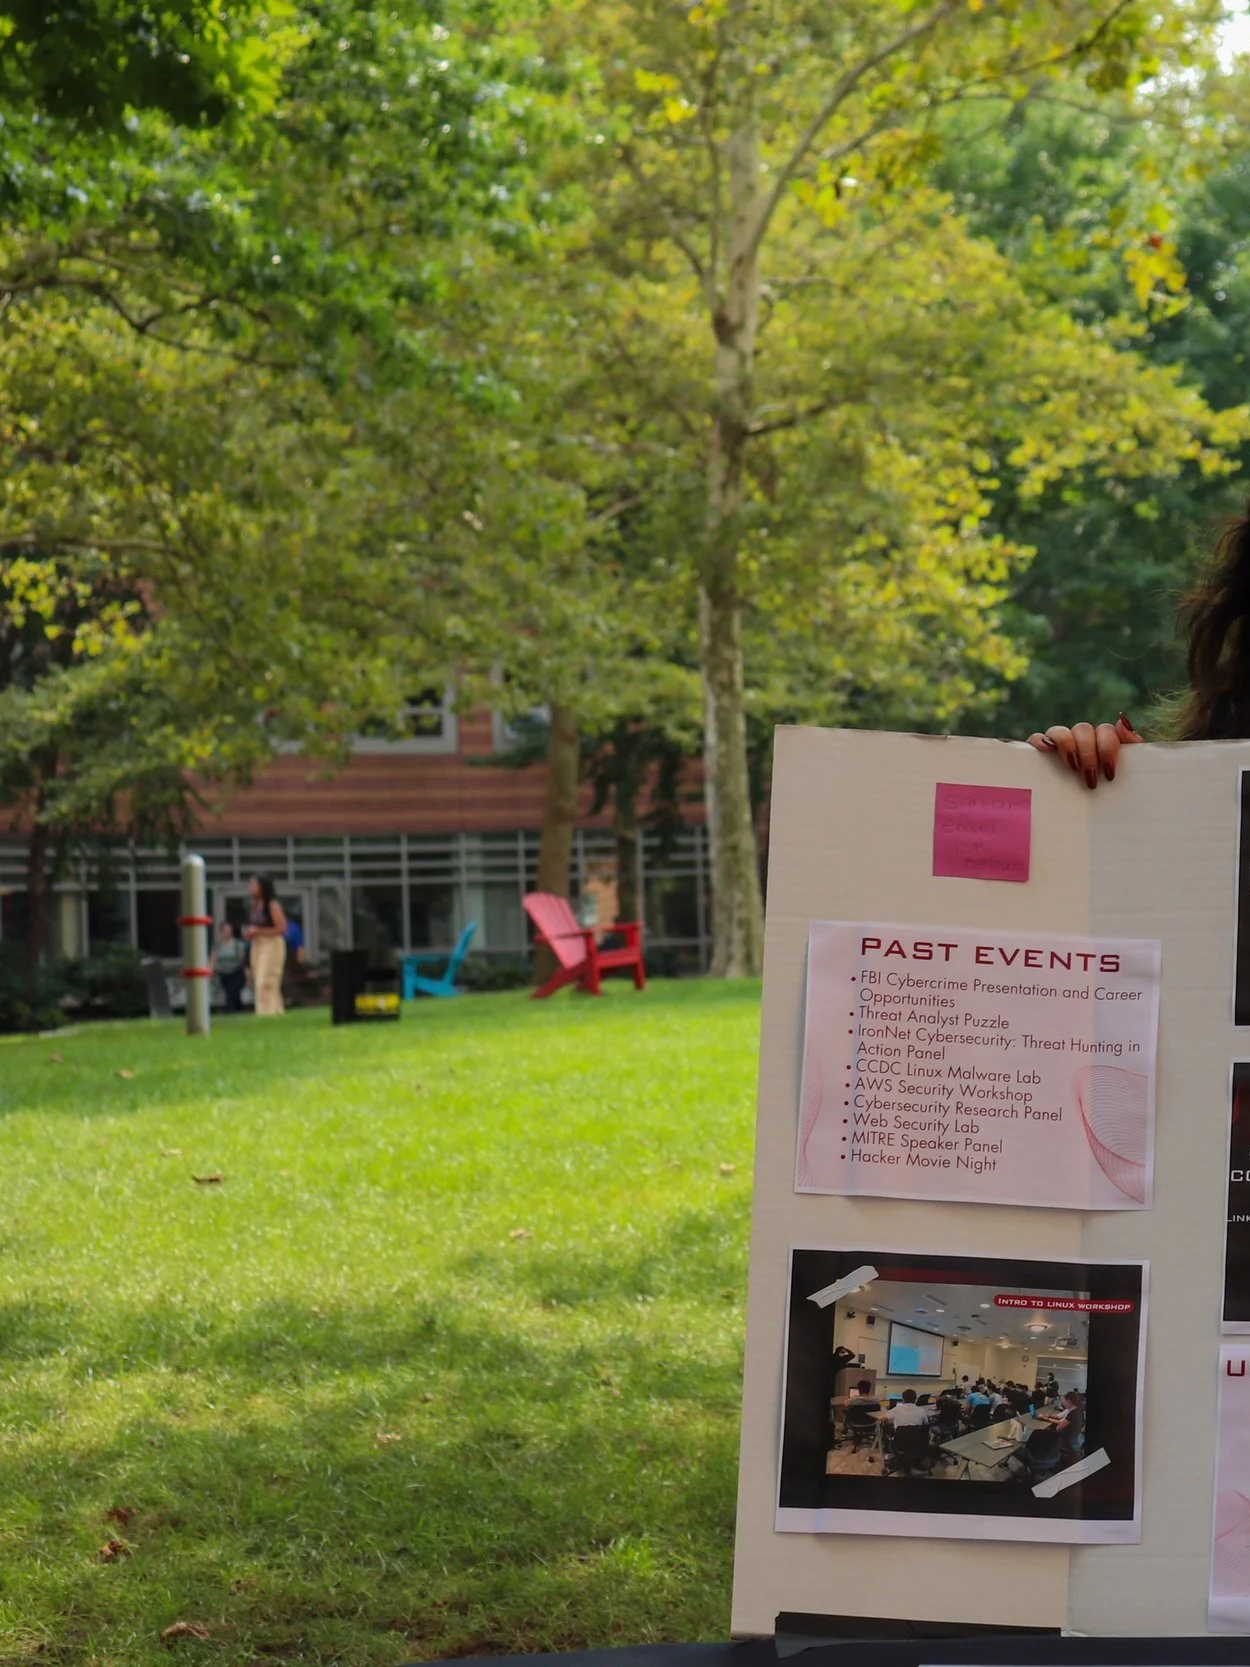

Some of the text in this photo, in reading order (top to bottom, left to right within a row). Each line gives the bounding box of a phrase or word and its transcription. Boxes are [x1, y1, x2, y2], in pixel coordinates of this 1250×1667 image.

[862, 938, 1119, 972] PAST EVENTS
[861, 970, 1142, 1000] FBI Cybercrime Presentation and Career
[860, 988, 955, 1008] Opportunities
[859, 1005, 1009, 1029] Threat Analyst Puzzle
[857, 1041, 945, 1060] Action Panel
[859, 1024, 1140, 1056] IronNet Cybersecurity: Threat Hunting in
[856, 1059, 1041, 1084] CCDC Linux Malware Lab
[855, 1077, 1032, 1105] AWS Security Workshop
[854, 1094, 1062, 1121] Cybersecurity Research Panel
[853, 1113, 979, 1136] Web Security Lab
[852, 1131, 1002, 1153] MITRE Speaker Panel
[851, 1149, 996, 1174] Hacker Movie Night
[998, 1298, 1028, 1306] INTRO
